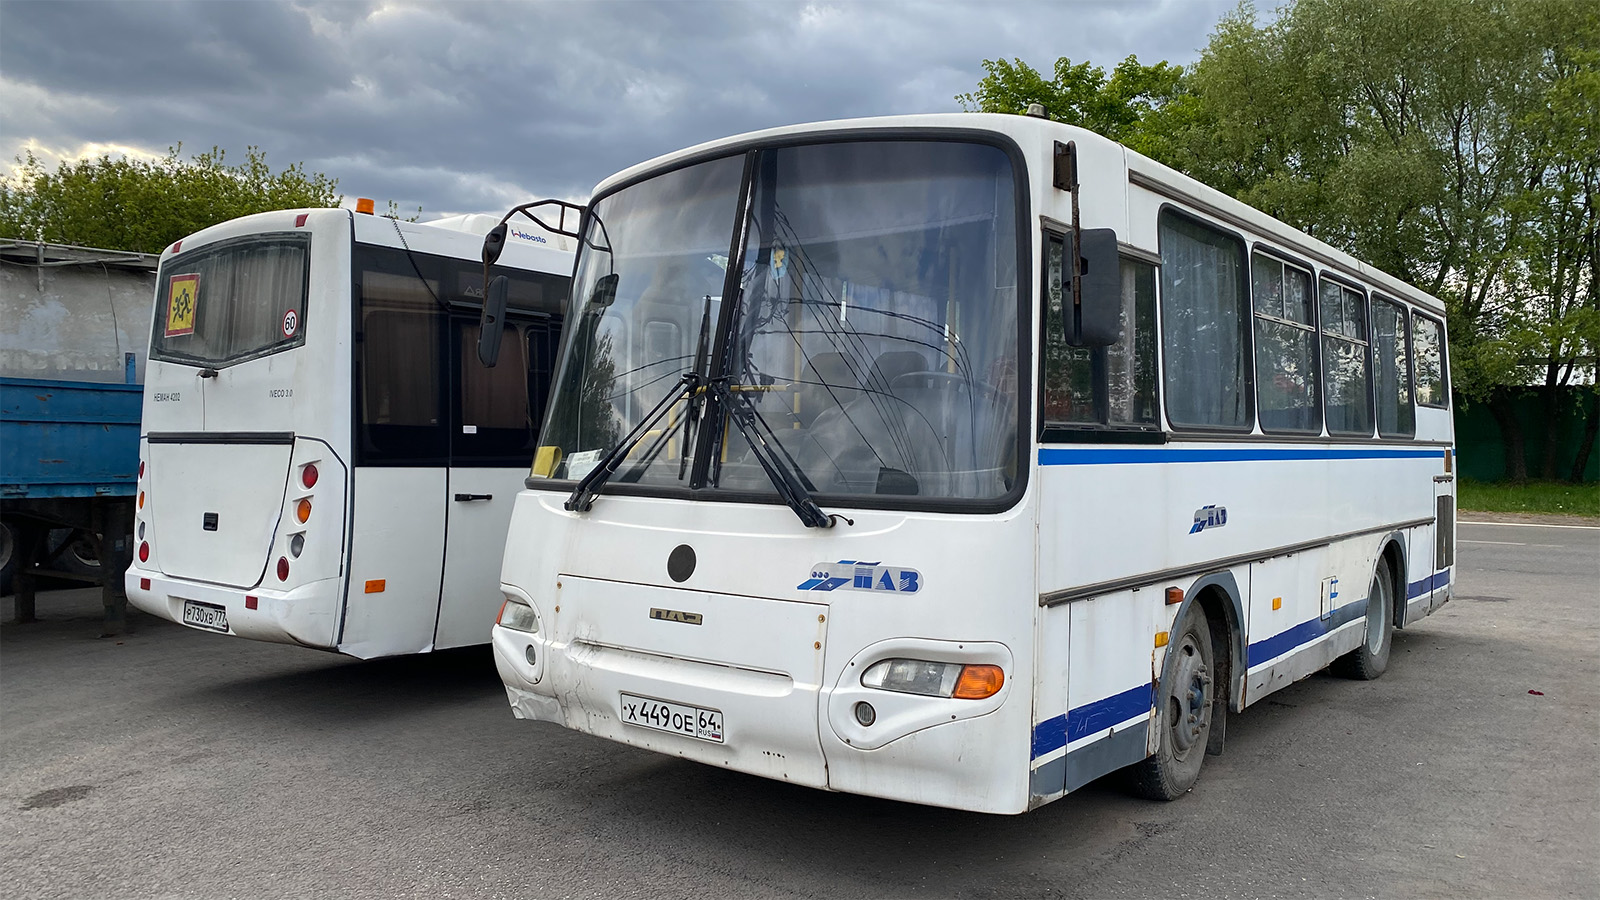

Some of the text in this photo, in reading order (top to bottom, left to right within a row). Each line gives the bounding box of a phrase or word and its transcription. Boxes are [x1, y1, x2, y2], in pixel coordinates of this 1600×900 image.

[511, 229, 546, 243] Webasto
[285, 316, 296, 331] 60
[153, 392, 181, 402] НЕМАН 4202
[269, 389, 285, 398] IVECO
[852, 567, 920, 593] ПАЗ
[214, 610, 226, 622] 777
[650, 608, 702, 625] ПАЗ
[698, 711, 717, 731] 64
[698, 728, 712, 738] RUS
